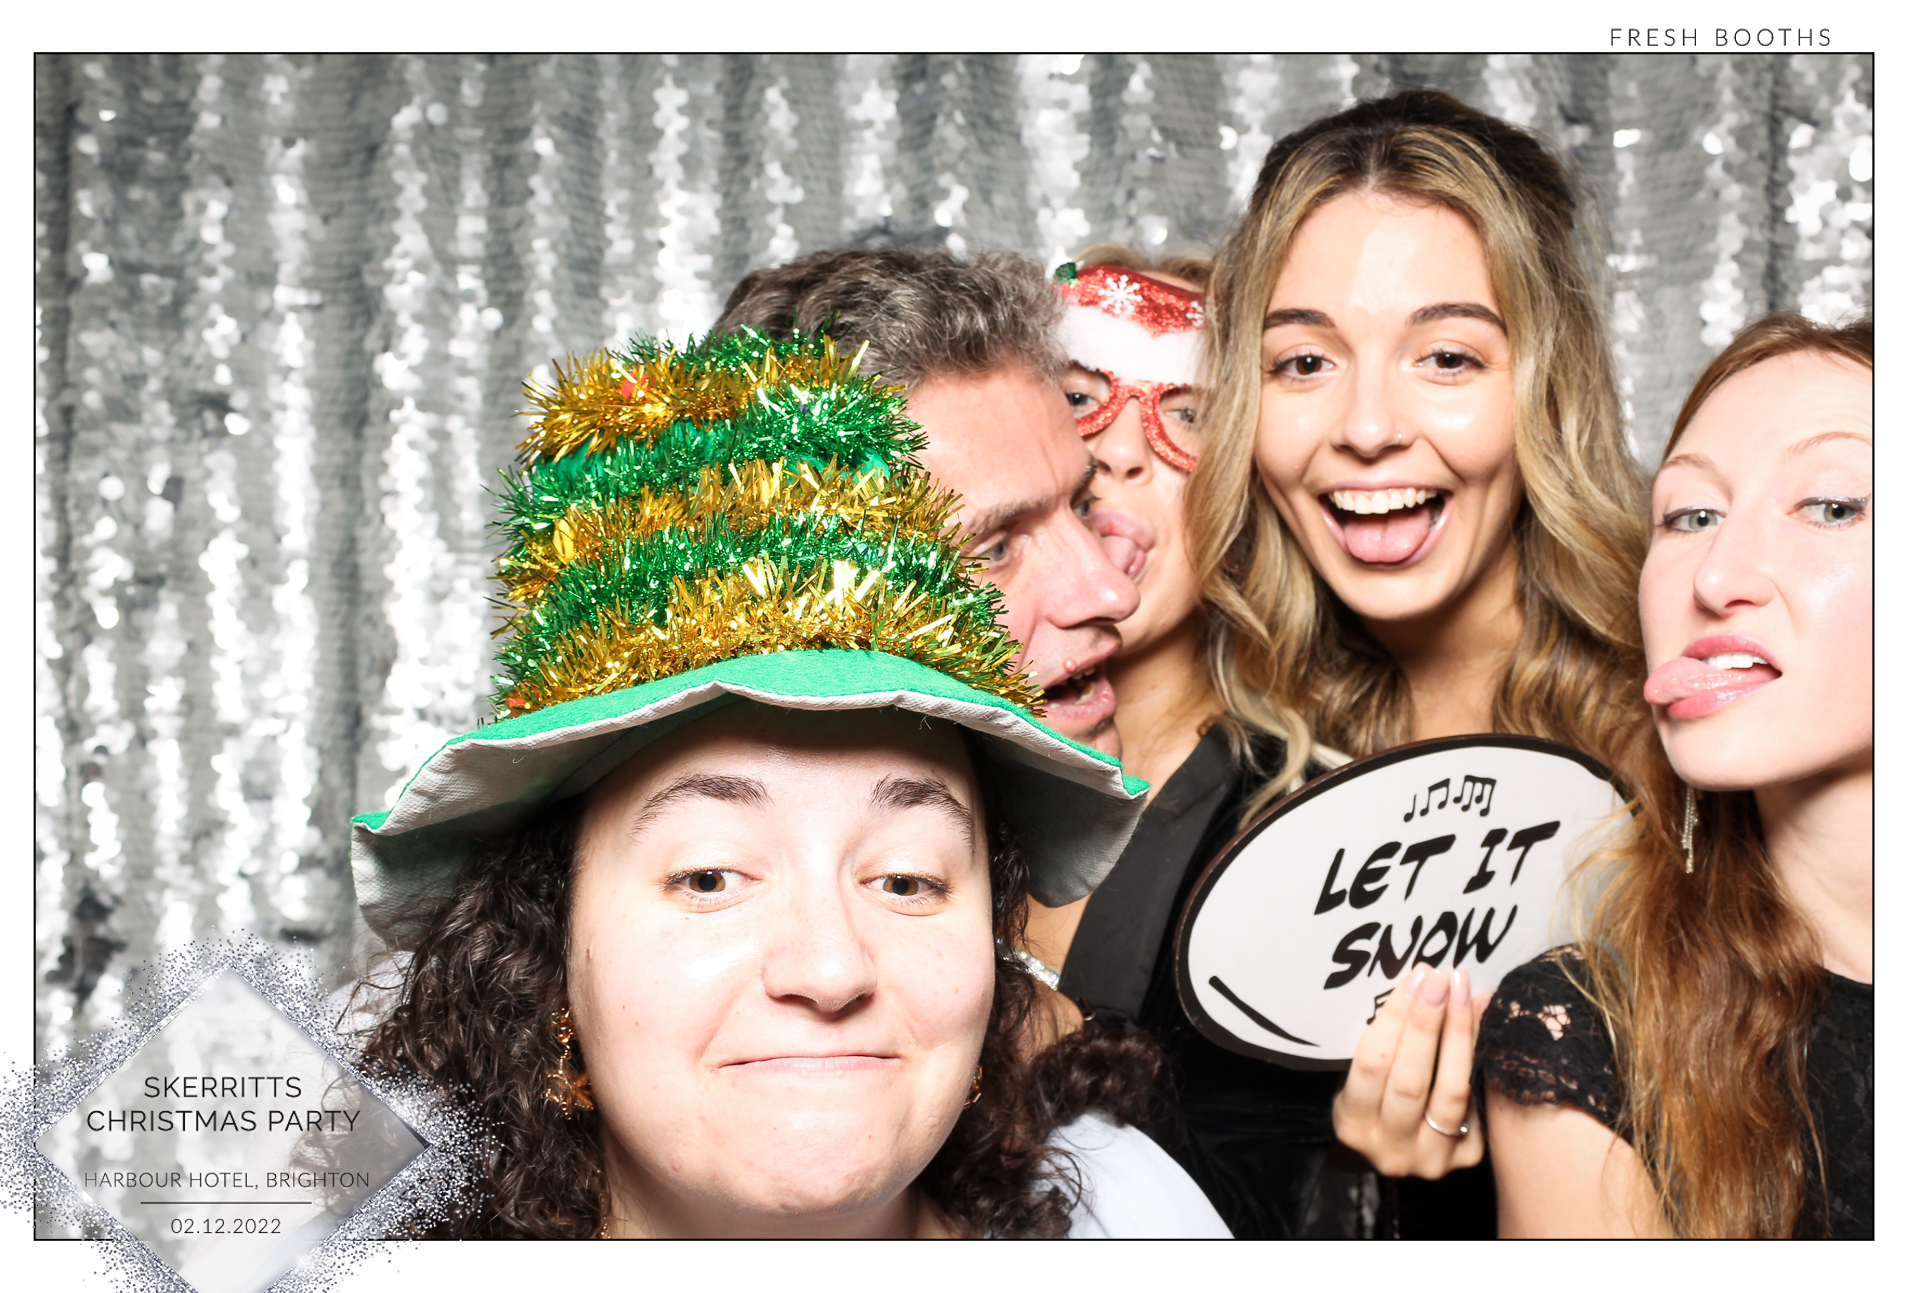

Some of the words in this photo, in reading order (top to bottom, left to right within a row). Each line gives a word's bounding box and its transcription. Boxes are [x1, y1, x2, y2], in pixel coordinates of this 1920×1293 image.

[1314, 833, 1456, 915] LET
[1463, 820, 1560, 894] IT
[1323, 904, 1518, 990] SNOW
